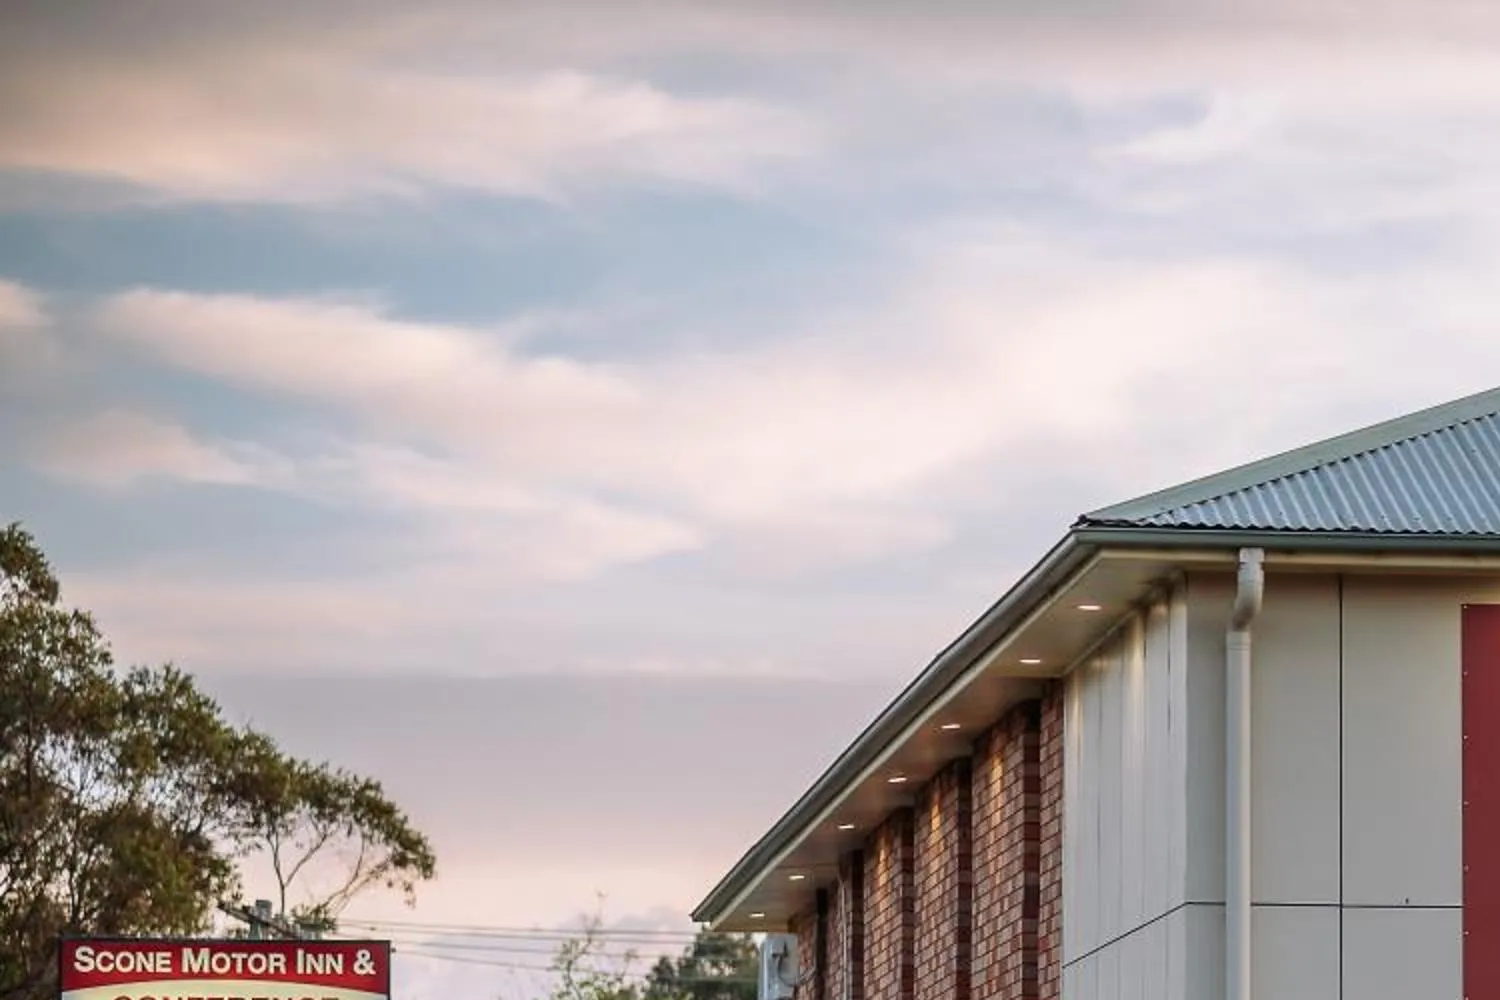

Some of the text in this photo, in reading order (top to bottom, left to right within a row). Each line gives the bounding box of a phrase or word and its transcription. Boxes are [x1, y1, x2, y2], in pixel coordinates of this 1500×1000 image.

[73, 945, 377, 976] SCONE MOTOR INN &
